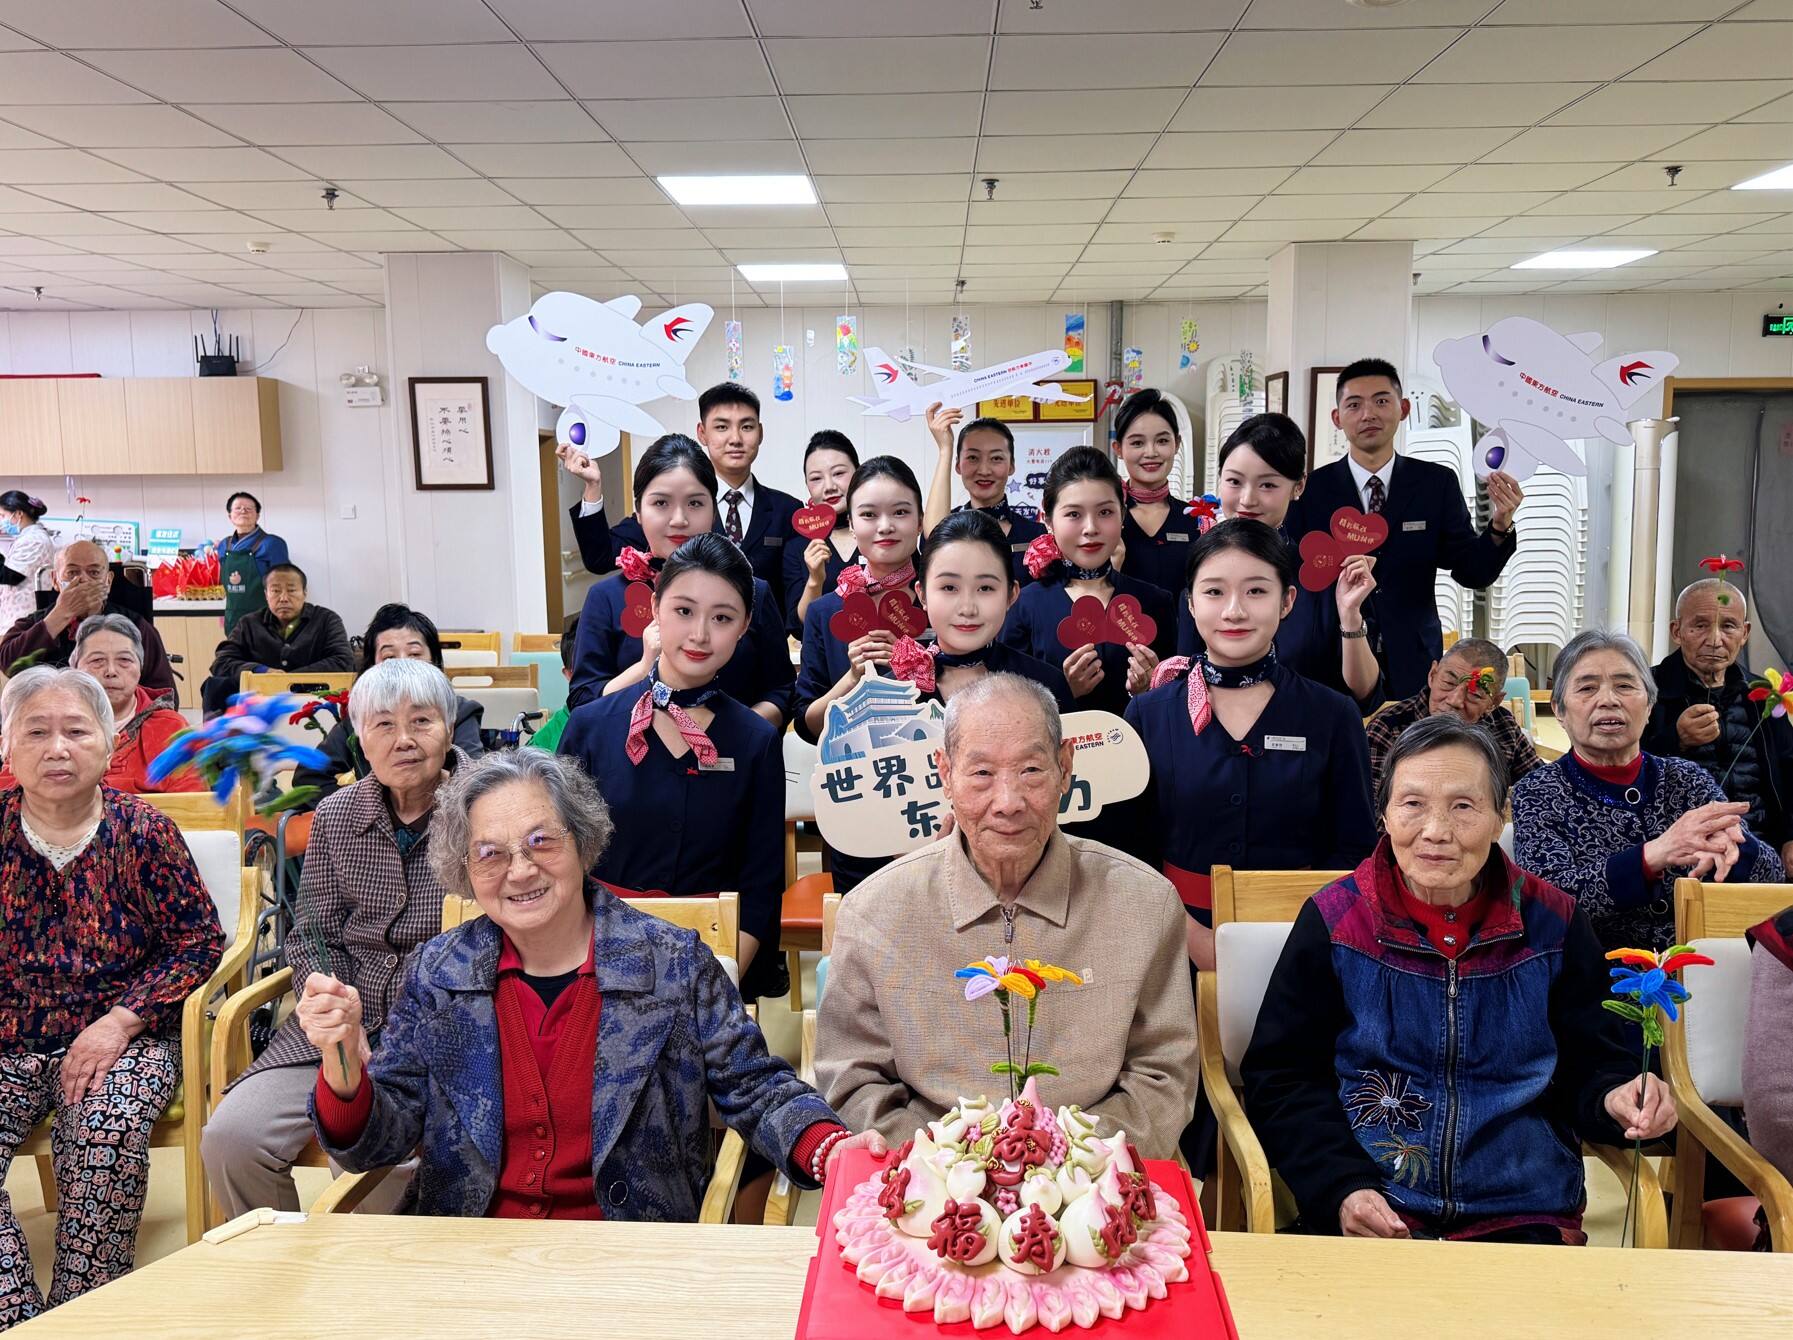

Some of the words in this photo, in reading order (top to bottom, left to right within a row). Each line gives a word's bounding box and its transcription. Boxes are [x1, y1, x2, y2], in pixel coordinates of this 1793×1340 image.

[1519, 371, 1560, 398] 中國東方航空
[1559, 393, 1577, 403] CHINA
[1577, 399, 1604, 408] EASTERN
[1074, 740, 1105, 751] EASTERN
[927, 1199, 987, 1262] 福
[1009, 1202, 1060, 1273] 寿
